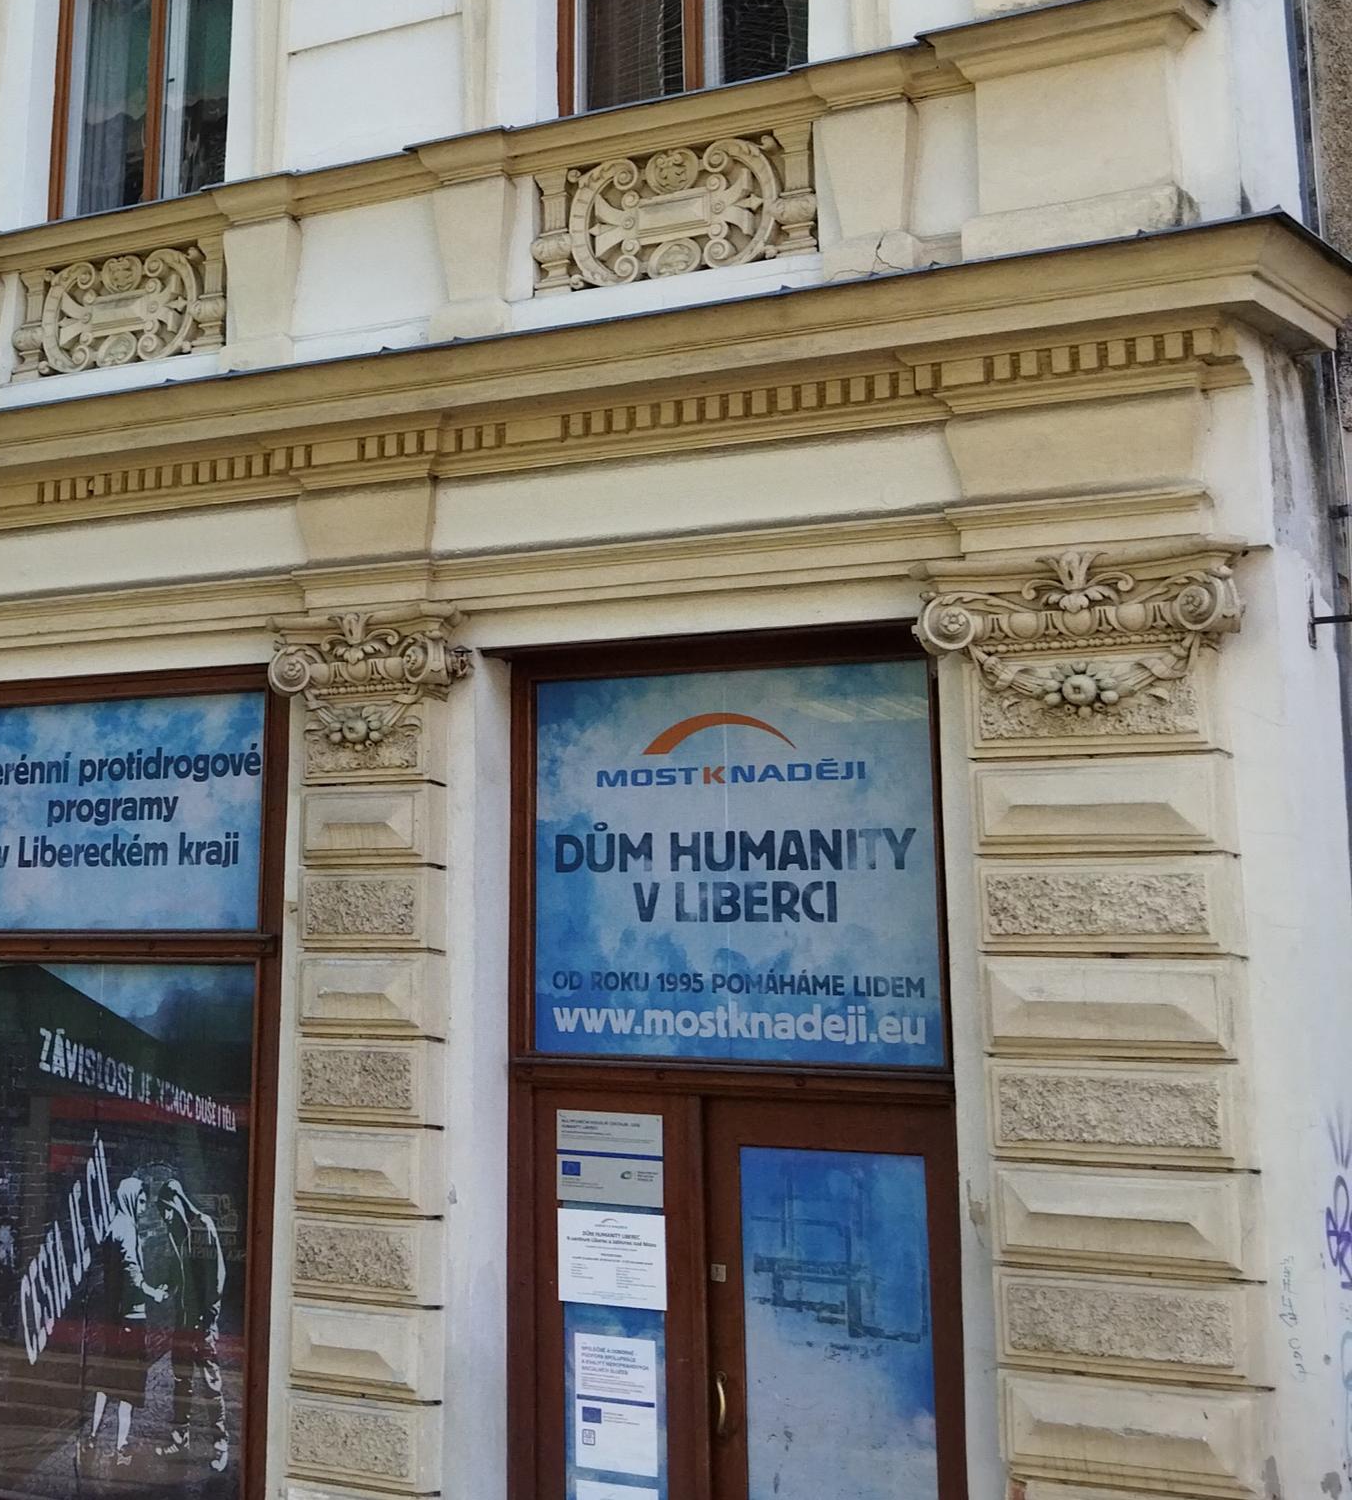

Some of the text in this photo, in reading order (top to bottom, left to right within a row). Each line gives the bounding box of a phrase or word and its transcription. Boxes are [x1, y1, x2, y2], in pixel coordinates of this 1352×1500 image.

[78, 743, 262, 787] protidrogové
[596, 758, 866, 788] MOST K NADĚJI
[47, 795, 179, 827] programy
[17, 833, 168, 868] Libereckém
[178, 831, 240, 867] kraji
[554, 822, 917, 873] DŮM HUMANITY
[633, 880, 838, 923] V LIBERCI
[552, 967, 926, 999] OD ROKU 1995 POMÁHÁME LIDEM
[552, 1002, 927, 1046] www.mostknadeji.eu
[39, 1026, 134, 1100] ZÁVISLOST
